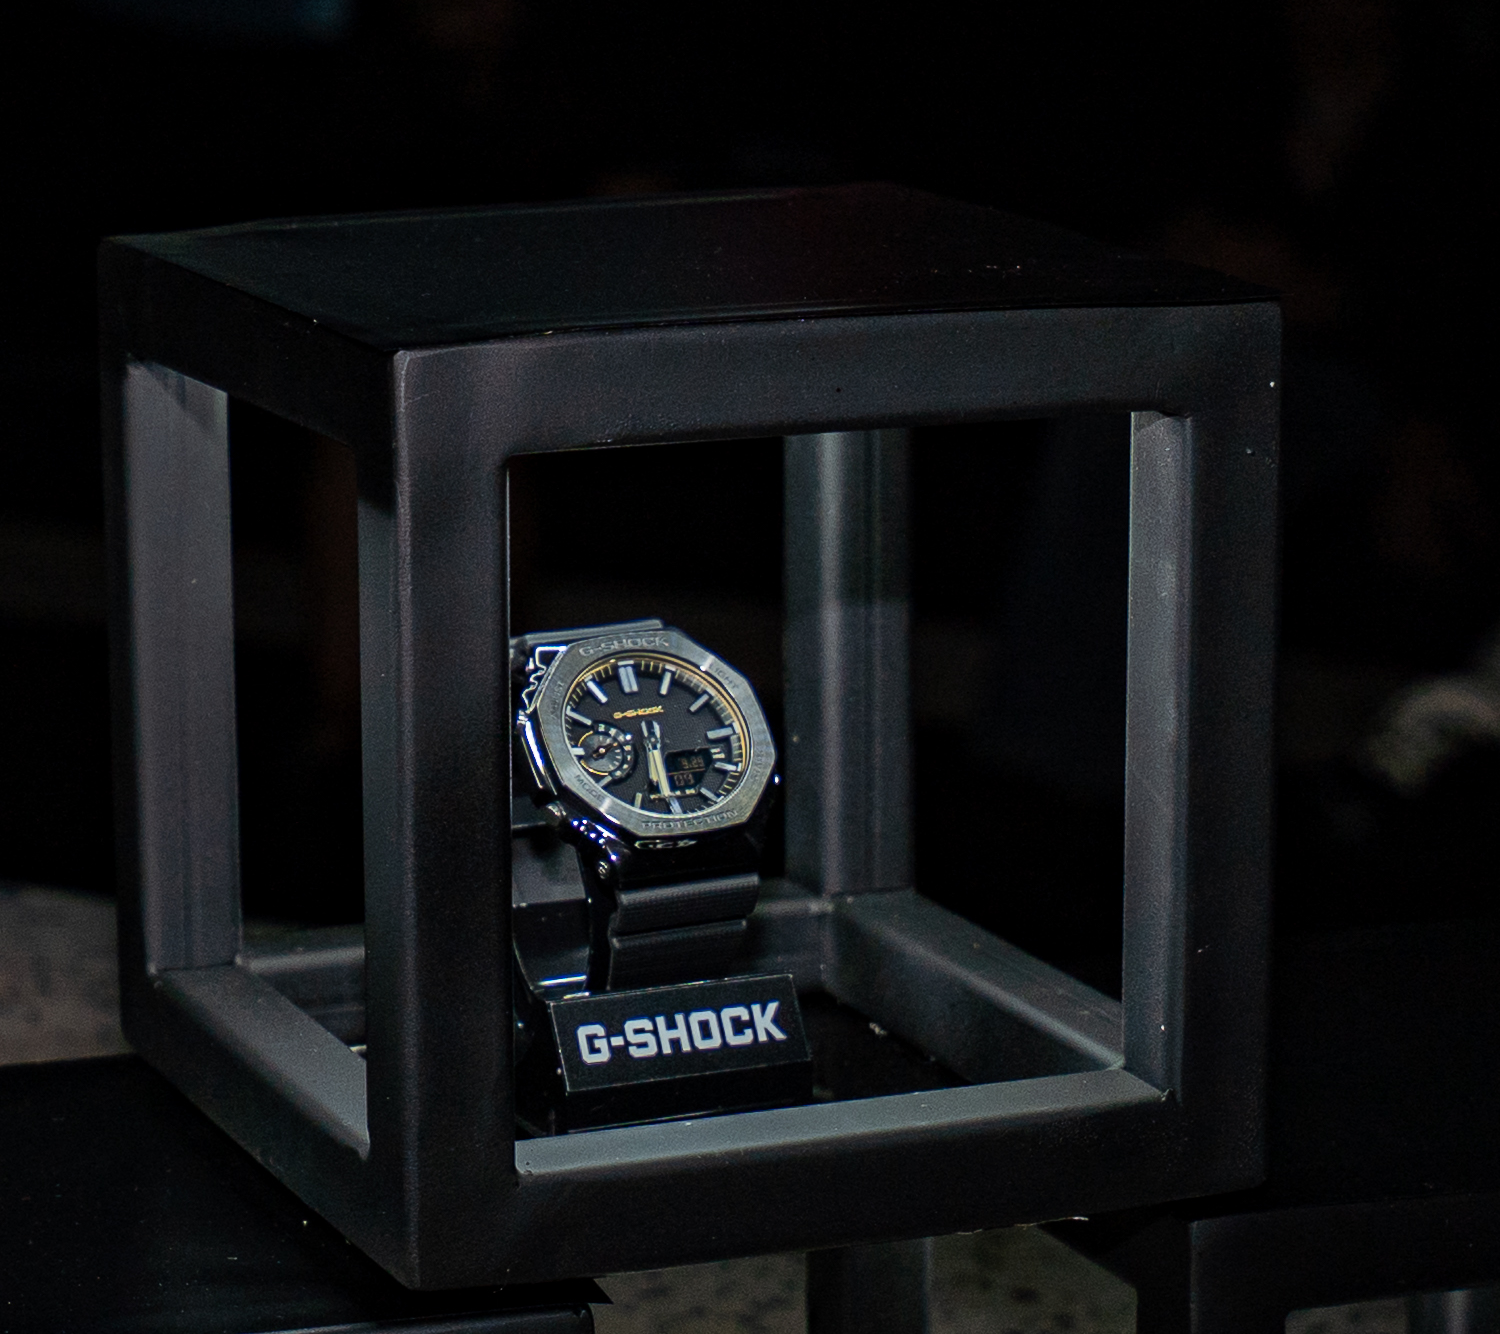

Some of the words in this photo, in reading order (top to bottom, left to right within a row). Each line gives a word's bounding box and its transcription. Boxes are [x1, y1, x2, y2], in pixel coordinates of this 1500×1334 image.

[579, 637, 669, 656] G-SHOCK
[641, 810, 738, 829] PROTECTION
[576, 1000, 788, 1065] G-SHOCK
